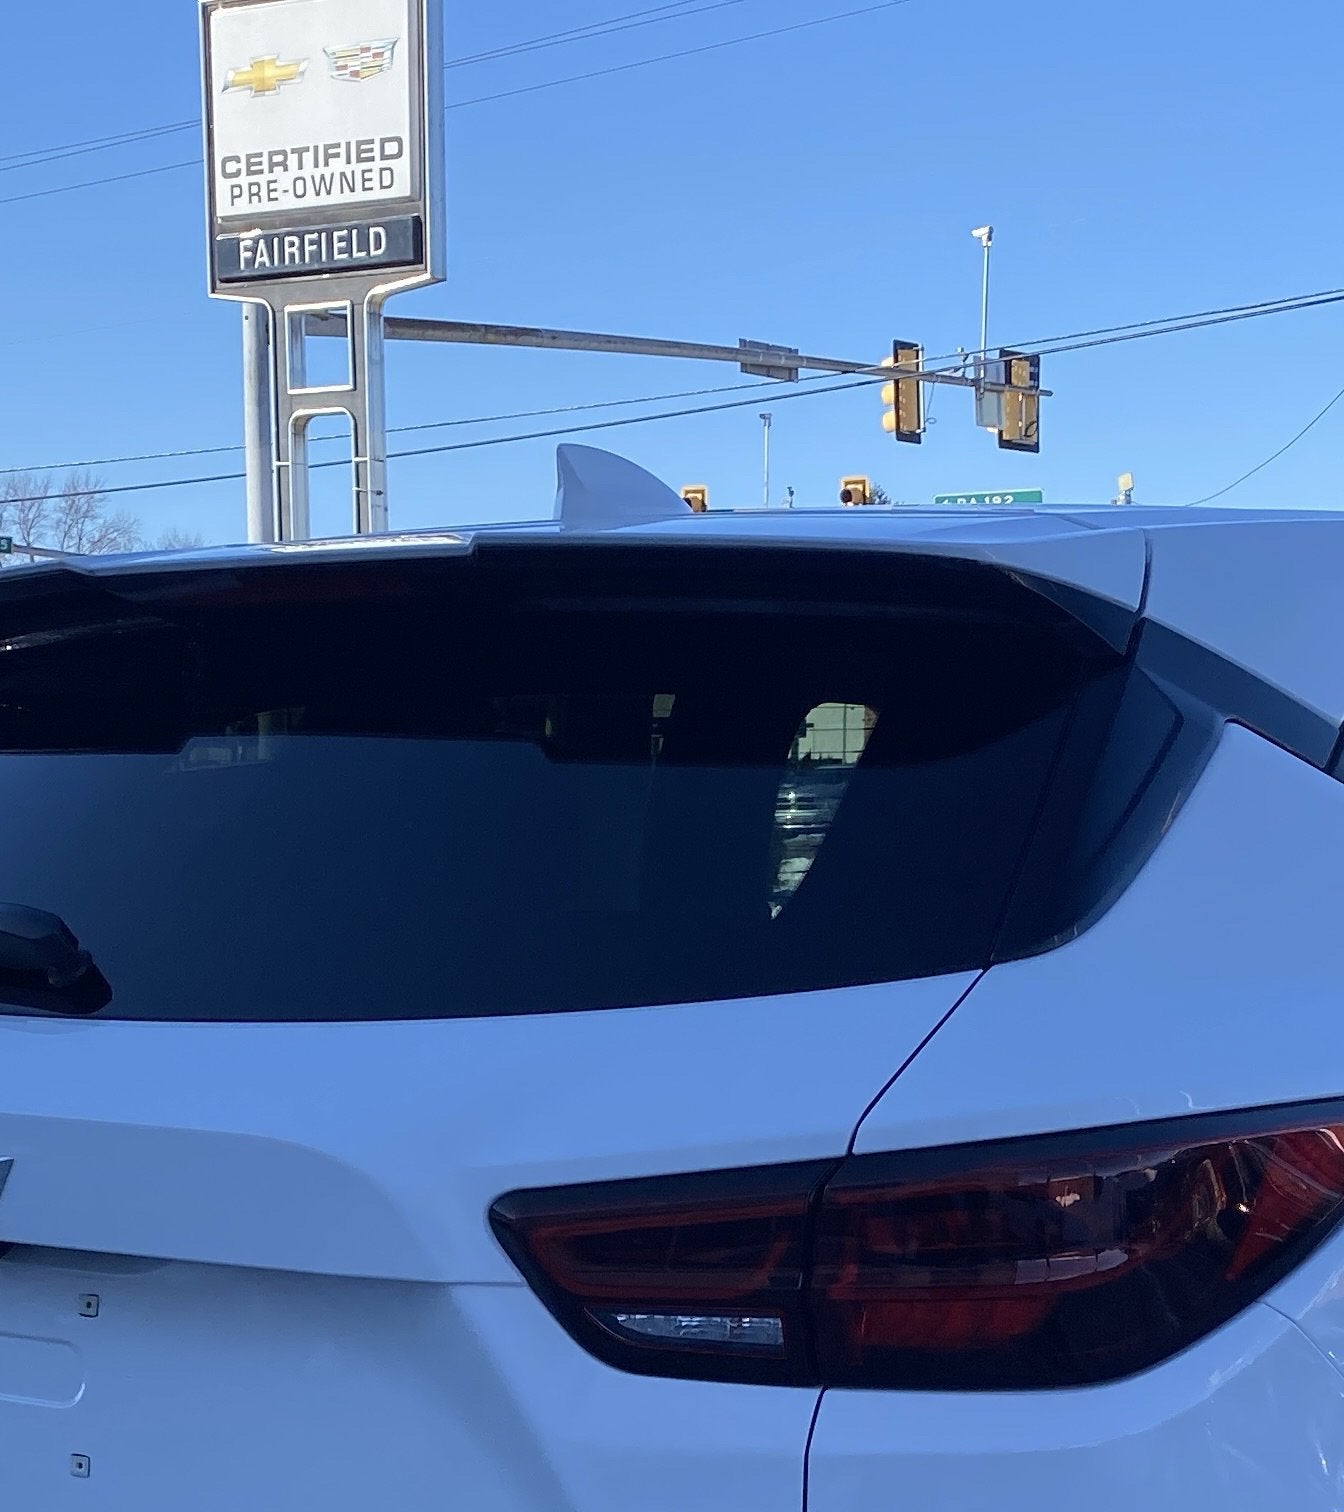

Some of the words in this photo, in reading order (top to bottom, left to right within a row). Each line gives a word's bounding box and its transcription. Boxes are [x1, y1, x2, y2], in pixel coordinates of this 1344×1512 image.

[220, 135, 404, 180] CERTIFIED
[229, 166, 395, 207] PRE-OWNED
[238, 226, 387, 271] FAIRFIELD
